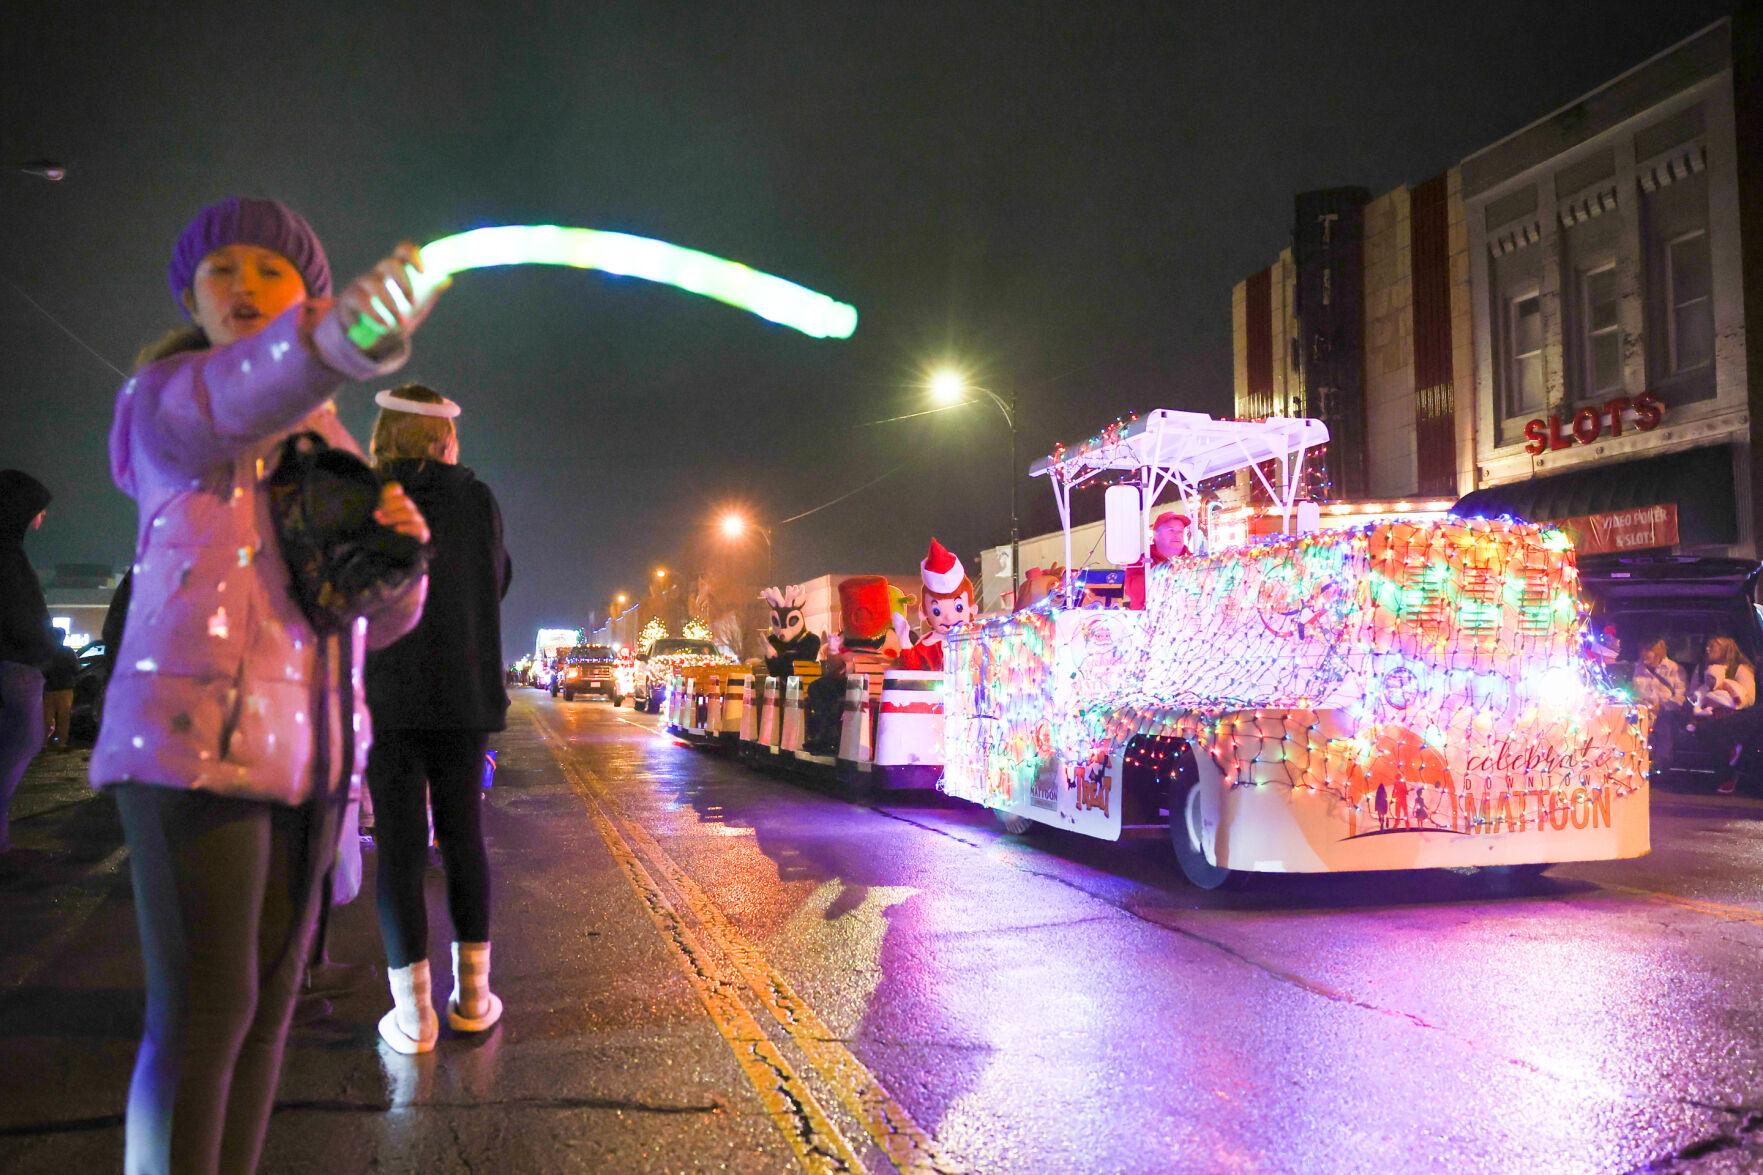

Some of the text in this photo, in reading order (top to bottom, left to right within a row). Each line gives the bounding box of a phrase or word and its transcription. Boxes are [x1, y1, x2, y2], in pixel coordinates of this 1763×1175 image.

[1523, 391, 1663, 456] SLOTS
[1466, 736, 1611, 774] celebrate
[1465, 773, 1612, 791] DOWNTOWN
[1465, 787, 1612, 835] MATTOON
